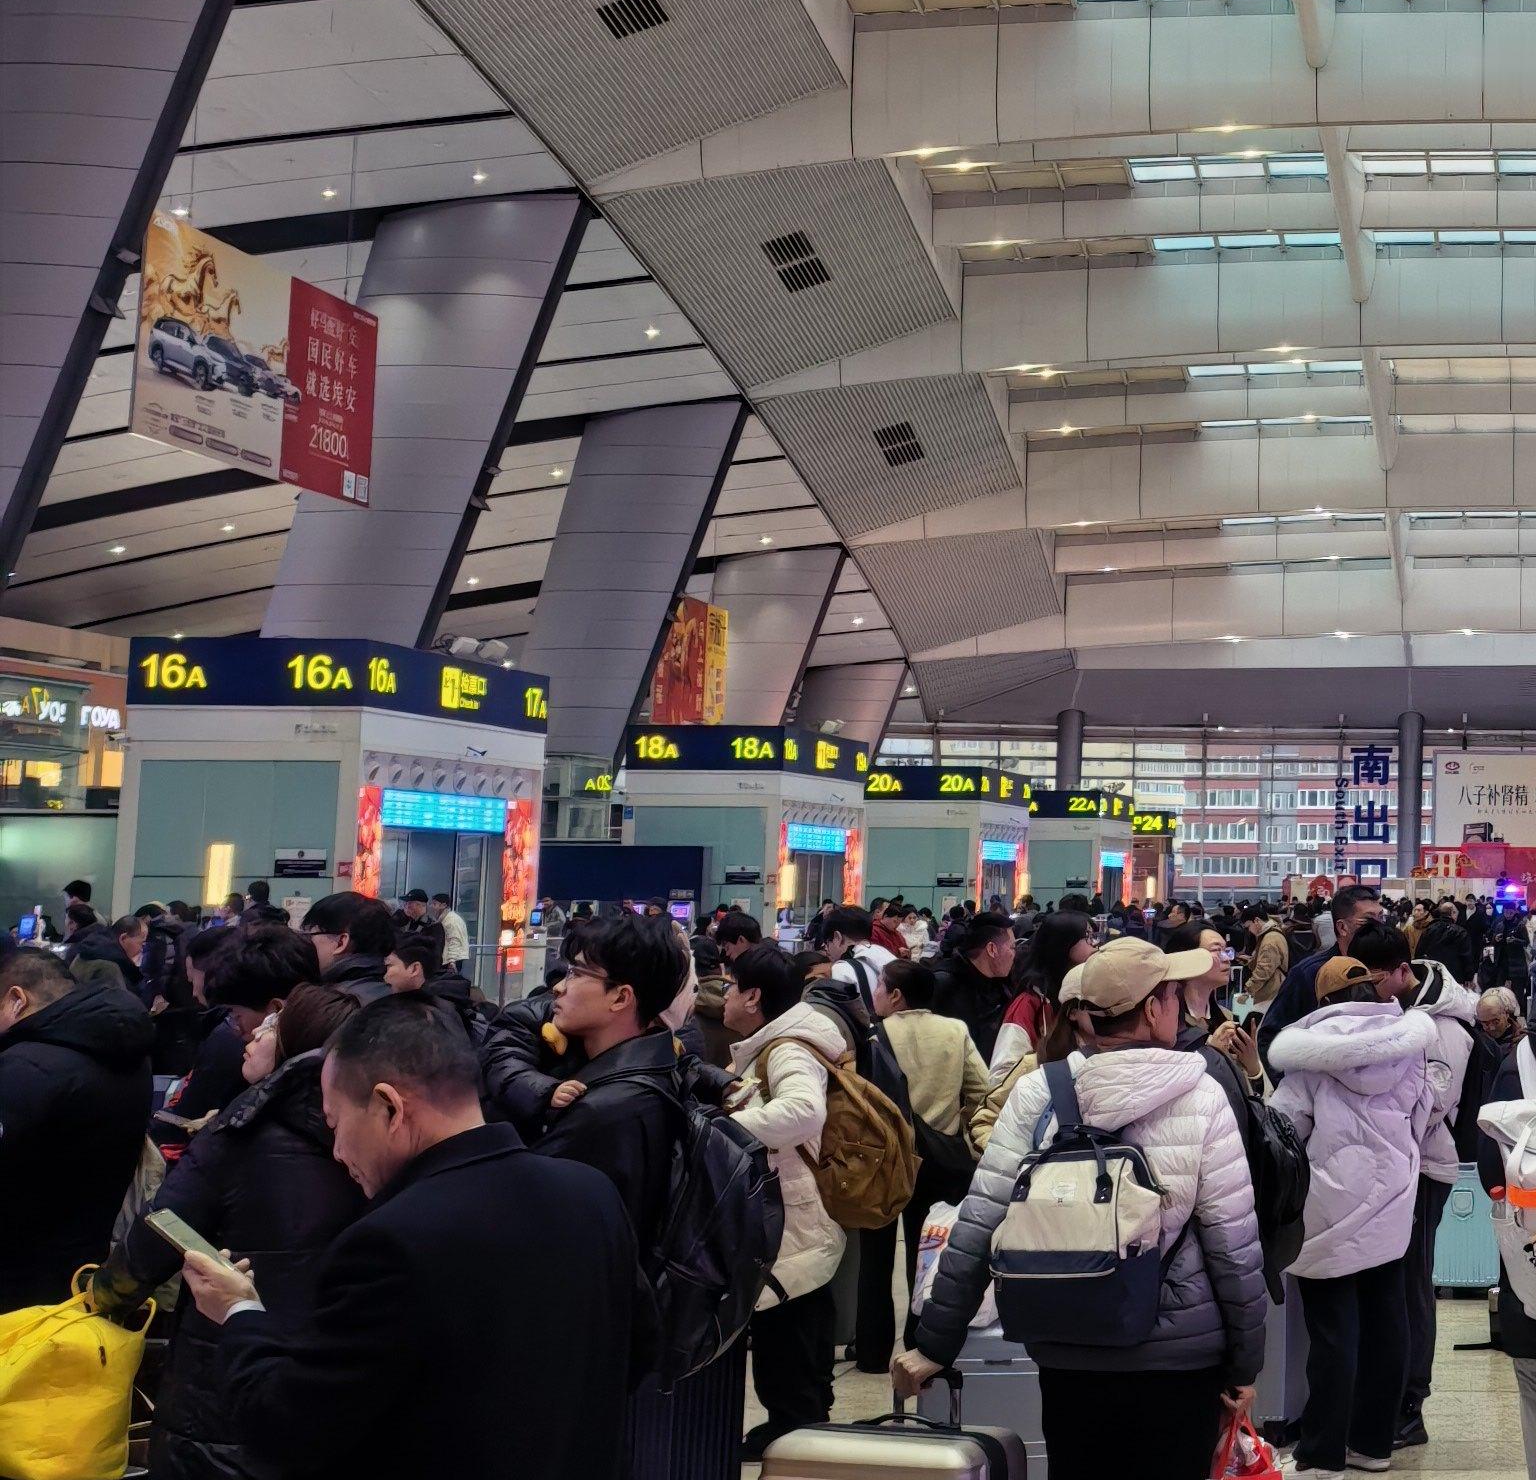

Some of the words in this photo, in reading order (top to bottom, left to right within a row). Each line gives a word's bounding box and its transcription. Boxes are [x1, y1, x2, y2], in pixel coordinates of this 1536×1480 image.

[308, 423, 348, 459] 21800
[142, 653, 208, 689] 16A
[287, 654, 353, 690] 16A
[368, 657, 396, 693] 16A
[525, 687, 547, 719] 17A
[635, 735, 679, 759] 18A
[731, 737, 774, 759] 18A
[867, 773, 902, 792] 20A
[939, 774, 975, 792] 20A
[1458, 783, 1528, 807] 八子补肾精
[1068, 797, 1097, 811] 22A
[1335, 778, 1348, 829] South
[1351, 744, 1392, 891] 南出口
[1141, 815, 1162, 831] 24
[1334, 837, 1348, 872] Exit
